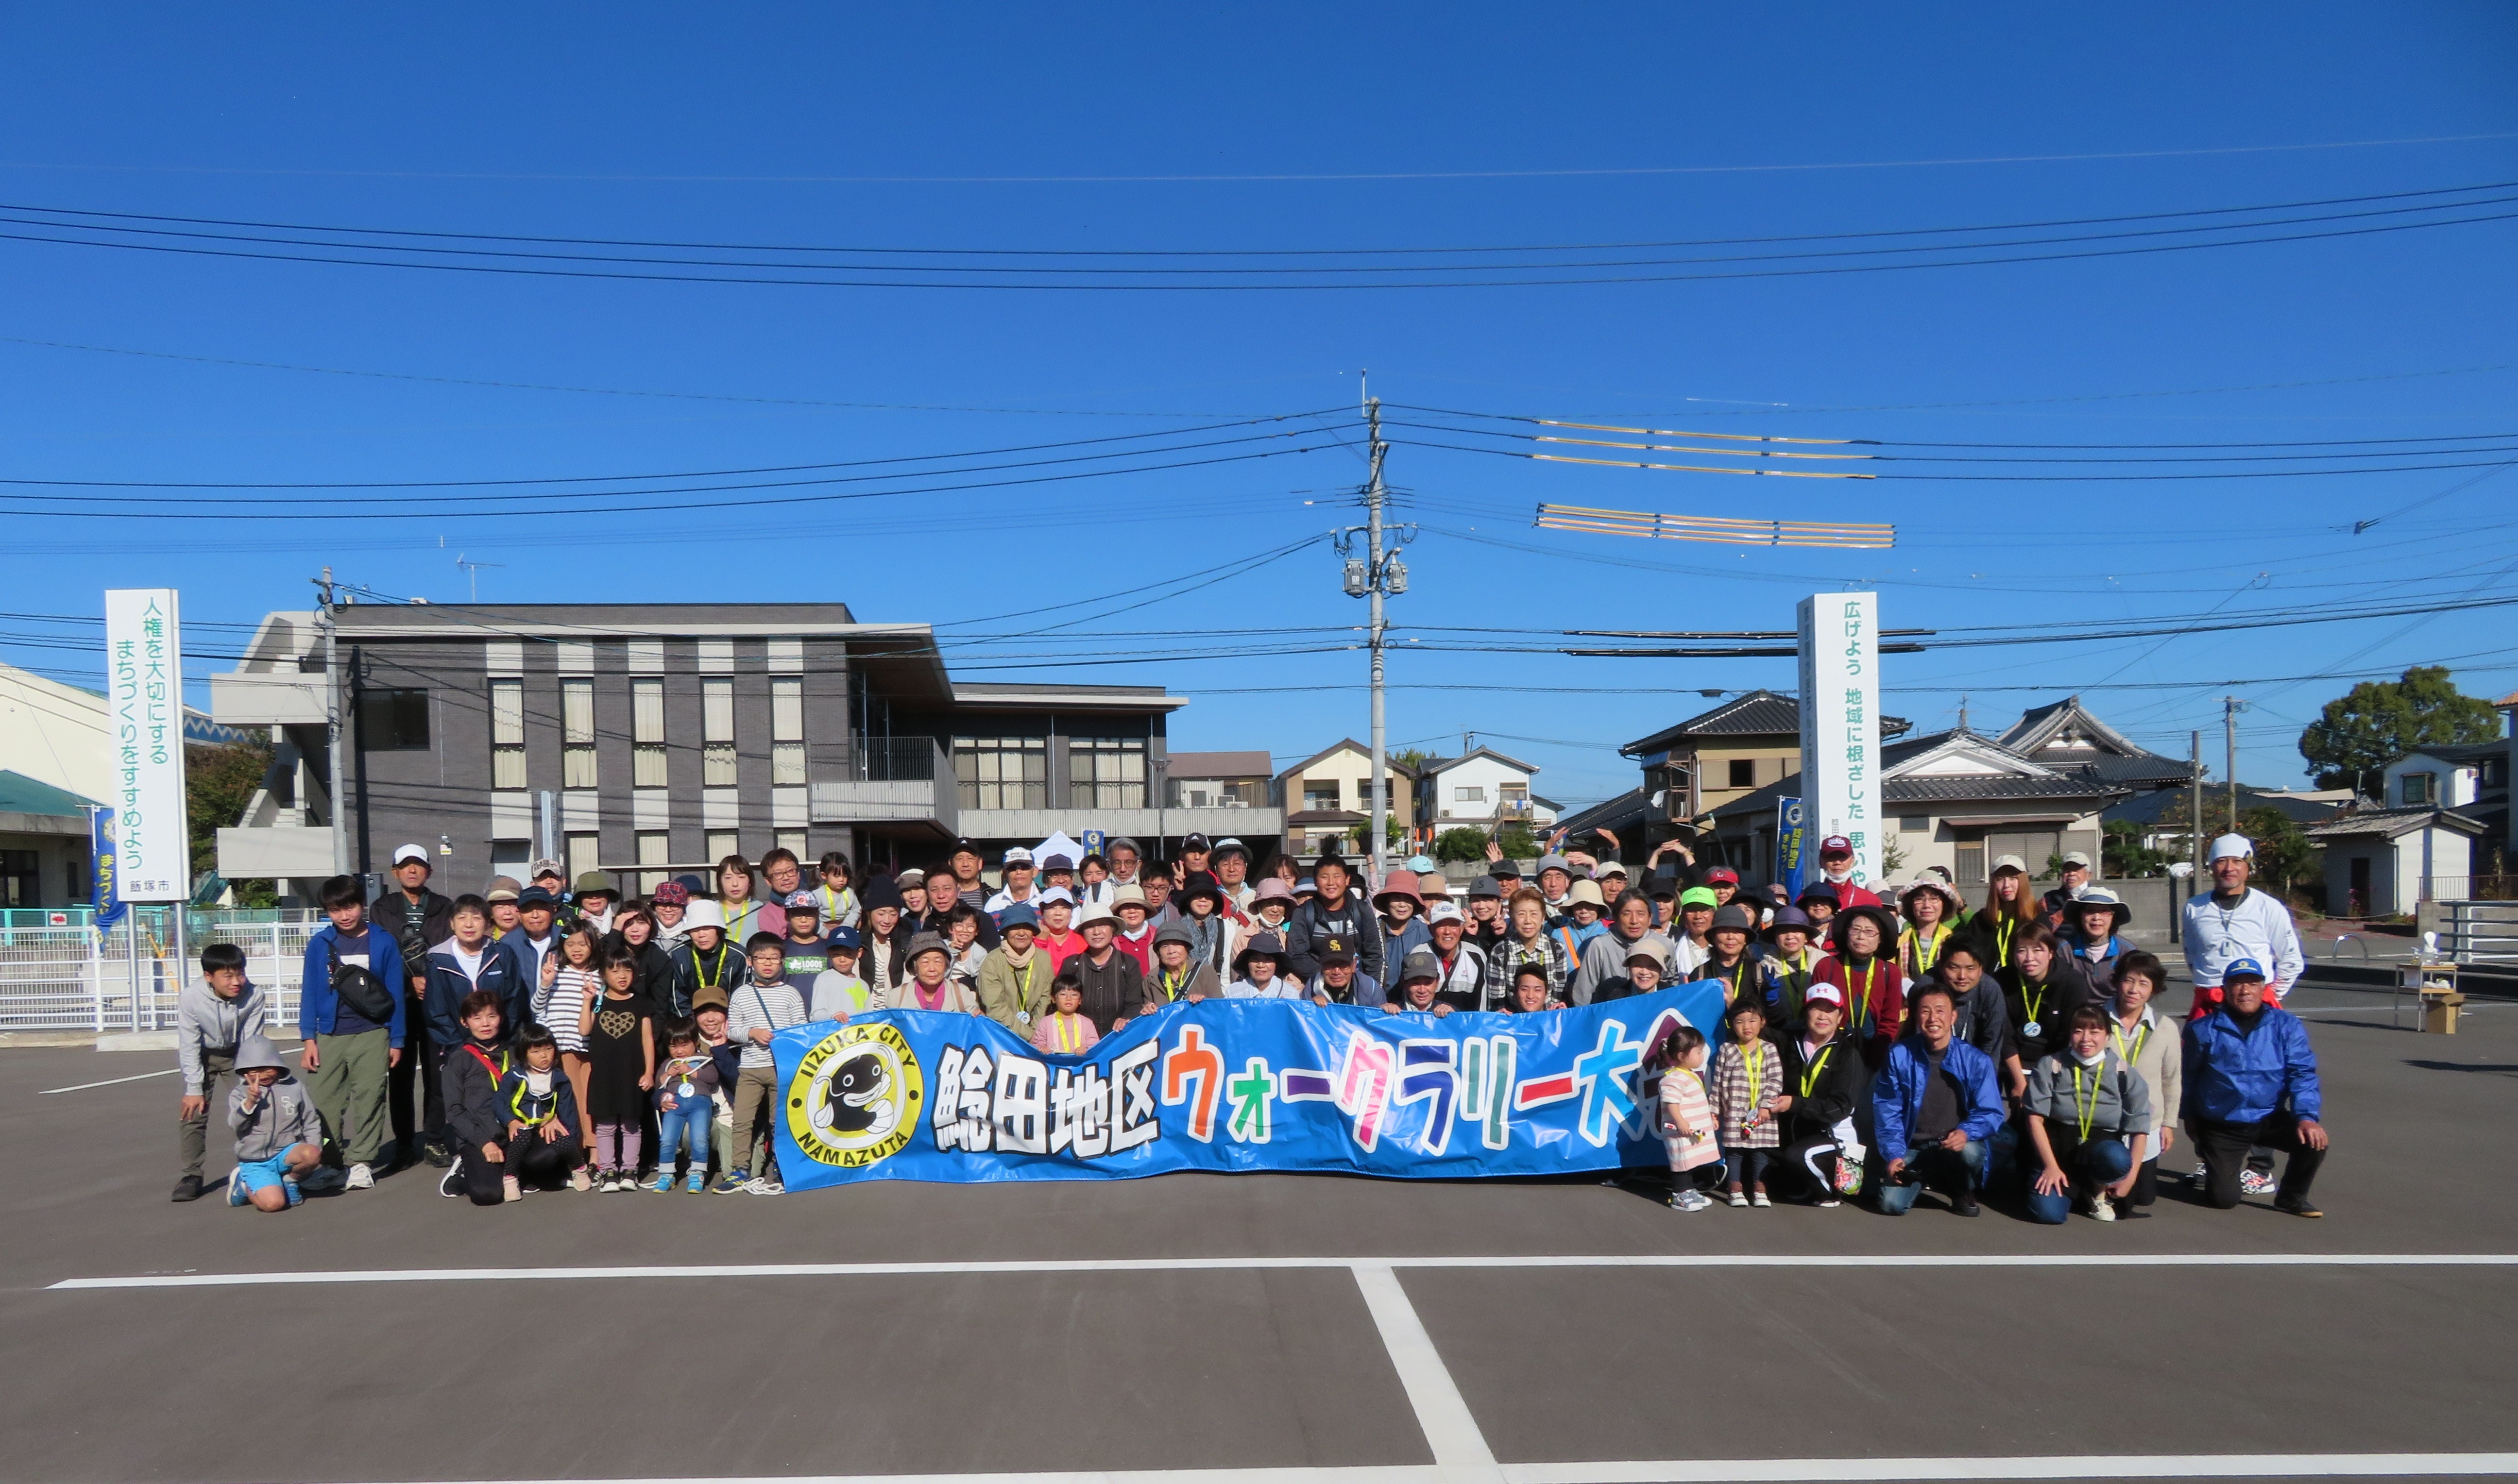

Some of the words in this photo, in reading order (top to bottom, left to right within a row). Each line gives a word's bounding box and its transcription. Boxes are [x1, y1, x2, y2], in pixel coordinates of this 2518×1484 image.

[1844, 601, 1862, 675] 広げよう
[143, 597, 169, 764] 人権を大切にする
[116, 639, 143, 870] まちづくりをすすめよう
[1845, 688, 1865, 819] 地域に根ざした
[130, 880, 170, 893] 飯塚市
[1479, 880, 1484, 889] S
[802, 960, 823, 968] LOGOS
[800, 1027, 869, 1078] IIZUKA
[879, 1027, 916, 1067] CITY
[798, 1130, 909, 1165] NAMAZUTA
